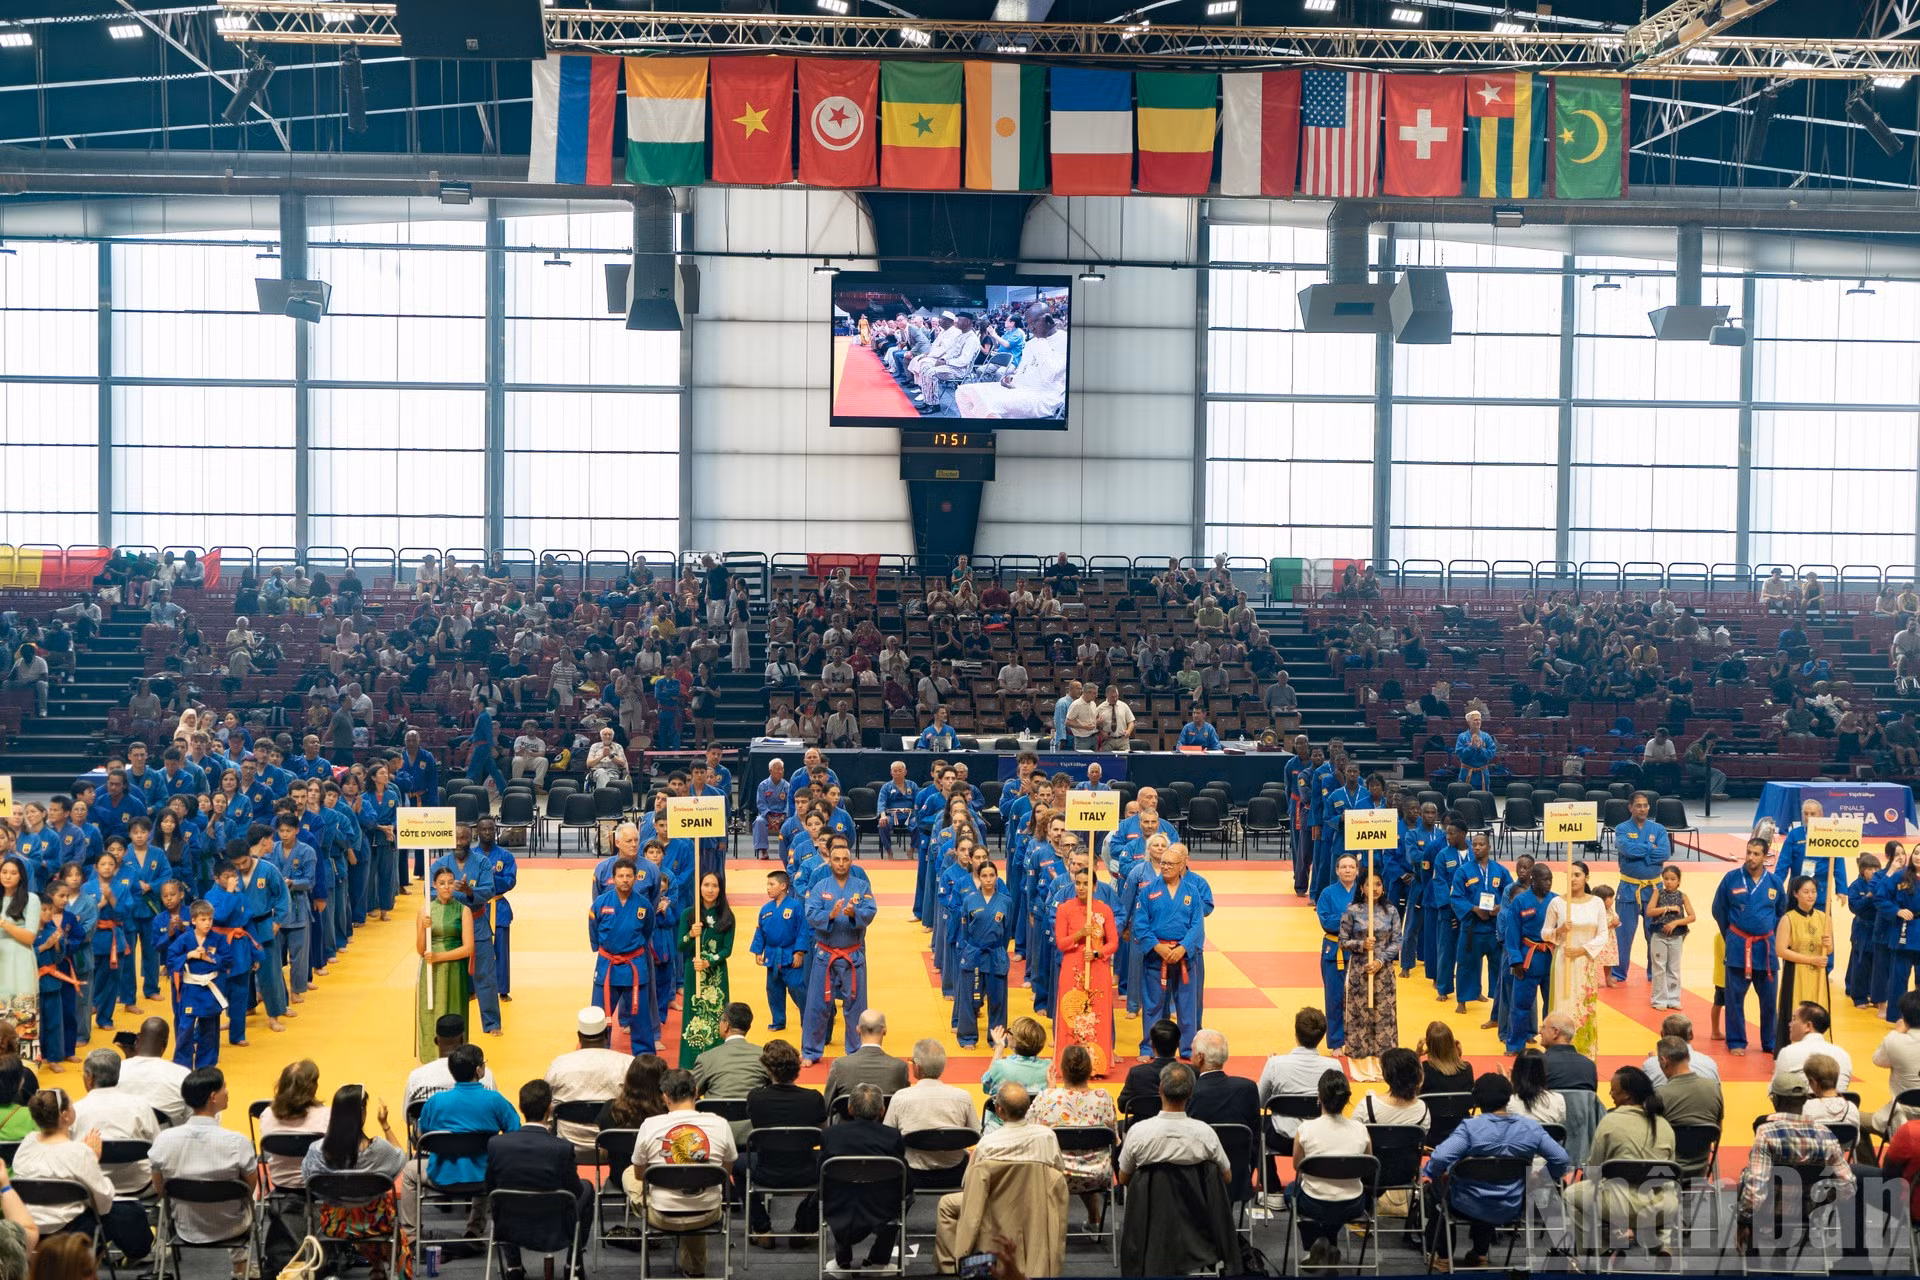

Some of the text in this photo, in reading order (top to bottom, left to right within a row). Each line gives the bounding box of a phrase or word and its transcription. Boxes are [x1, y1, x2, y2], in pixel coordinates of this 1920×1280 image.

[1080, 812, 1106, 821] ITALY
[681, 818, 712, 828] SPAIN
[1559, 823, 1582, 832] MALI
[400, 829, 453, 838] CÔTE D'IVOIRE
[1356, 830, 1387, 840] JAPAN
[1808, 838, 1860, 848] MOROCCO
